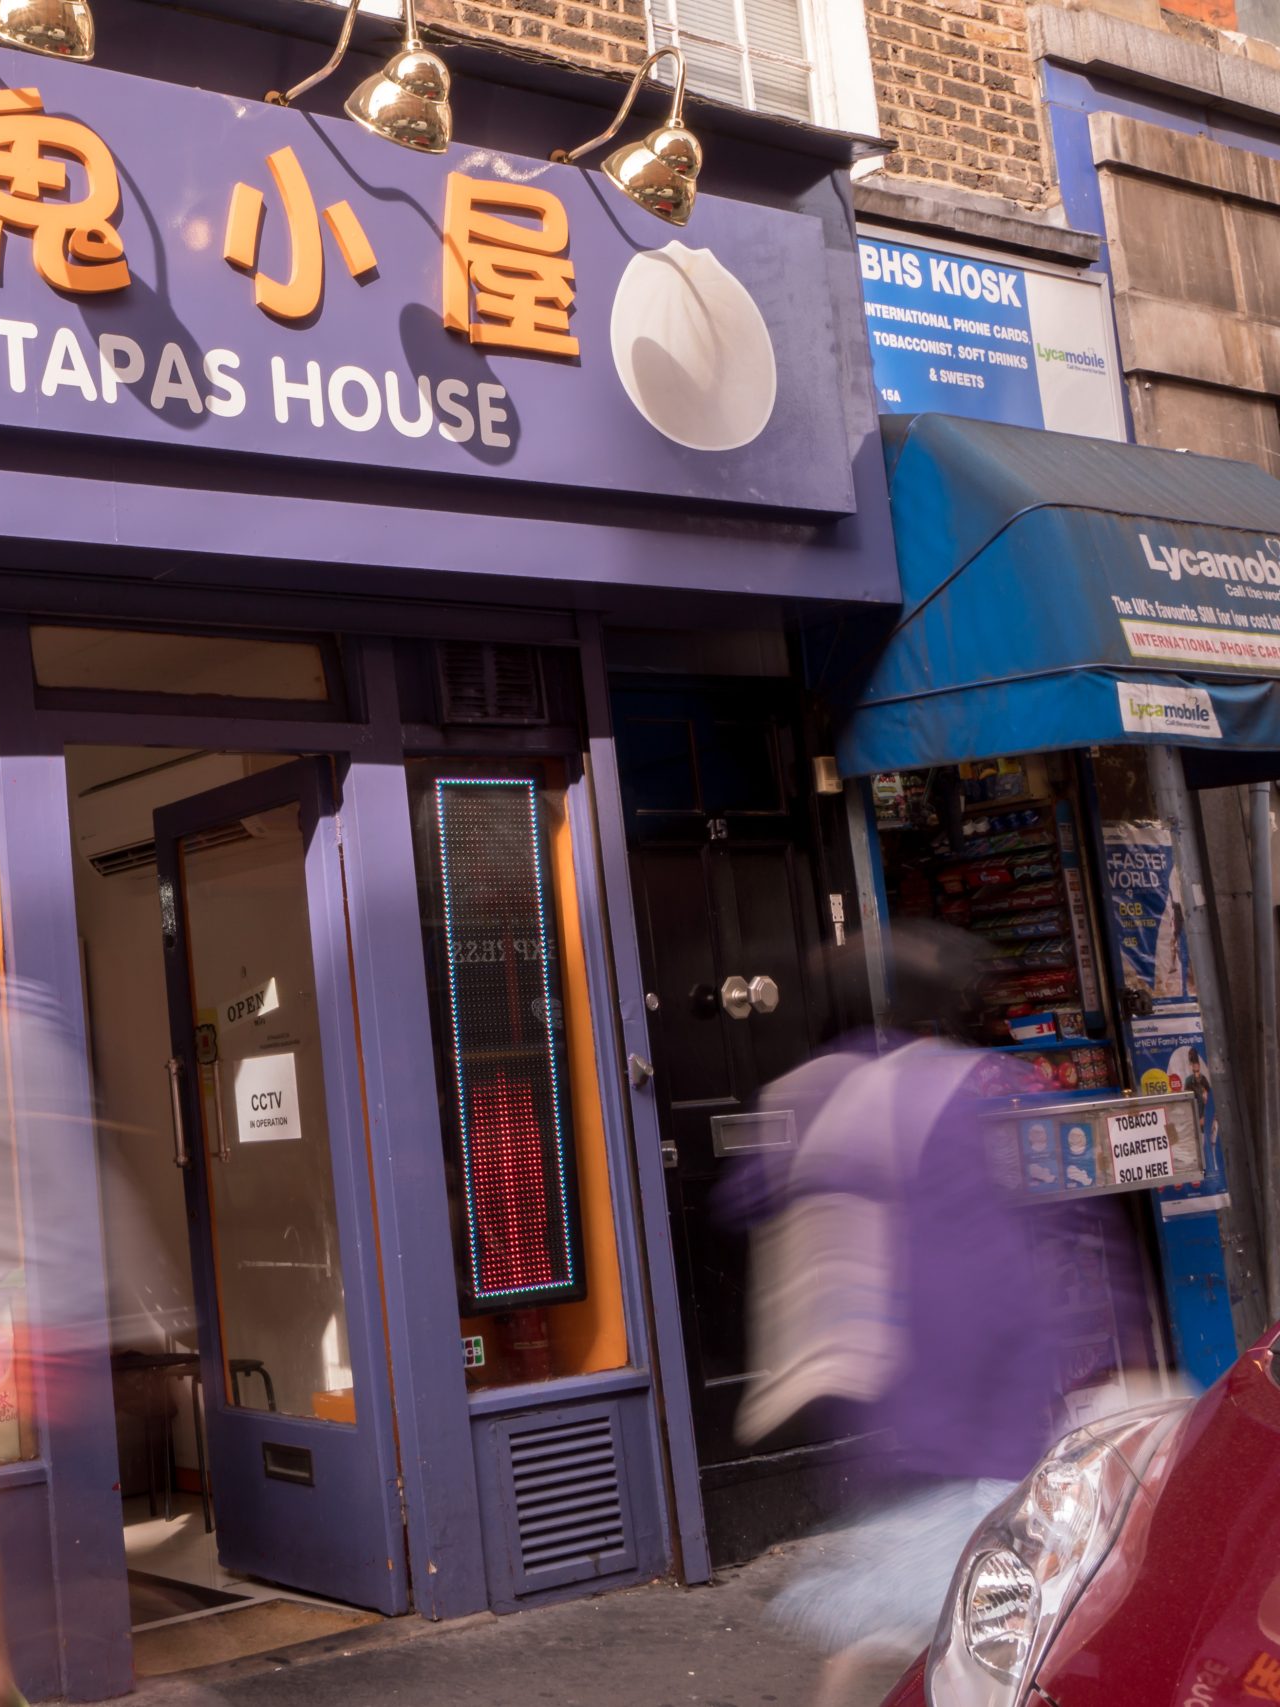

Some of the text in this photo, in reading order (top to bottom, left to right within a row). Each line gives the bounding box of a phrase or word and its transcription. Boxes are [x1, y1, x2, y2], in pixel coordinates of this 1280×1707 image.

[858, 243, 1022, 308] BHS KIOSK
[864, 301, 952, 330] INTERNATIONAL
[953, 317, 991, 337] PHONE
[873, 331, 1028, 370] TOBACCONIST, SOFT DRINKS
[1036, 342, 1105, 369] Lycamobile
[929, 367, 985, 389] & SWEETS
[270, 355, 511, 448] HOUSE
[881, 388, 901, 402] 15A
[1138, 533, 1280, 586] Lycamob
[1225, 583, 1246, 598] Call
[1111, 595, 1132, 615] The
[1131, 597, 1156, 618] UK's
[1155, 600, 1198, 622] favourite
[1197, 605, 1217, 624] SIM
[1217, 608, 1231, 625] for
[1231, 609, 1248, 628] low
[1250, 614, 1270, 630] cost
[1131, 632, 1280, 660] INTERNATIONAL PHONE CAR
[1128, 697, 1209, 722] Lycamobile
[706, 819, 728, 840] 15
[227, 990, 265, 1022] OPEN
[251, 1090, 282, 1112] CCTV
[249, 1117, 288, 1129] IN OPERATION
[1115, 1111, 1158, 1131] TOBACCO
[1113, 1135, 1168, 1159] CIGARETTES
[1119, 1161, 1169, 1183] SOLD HERE
